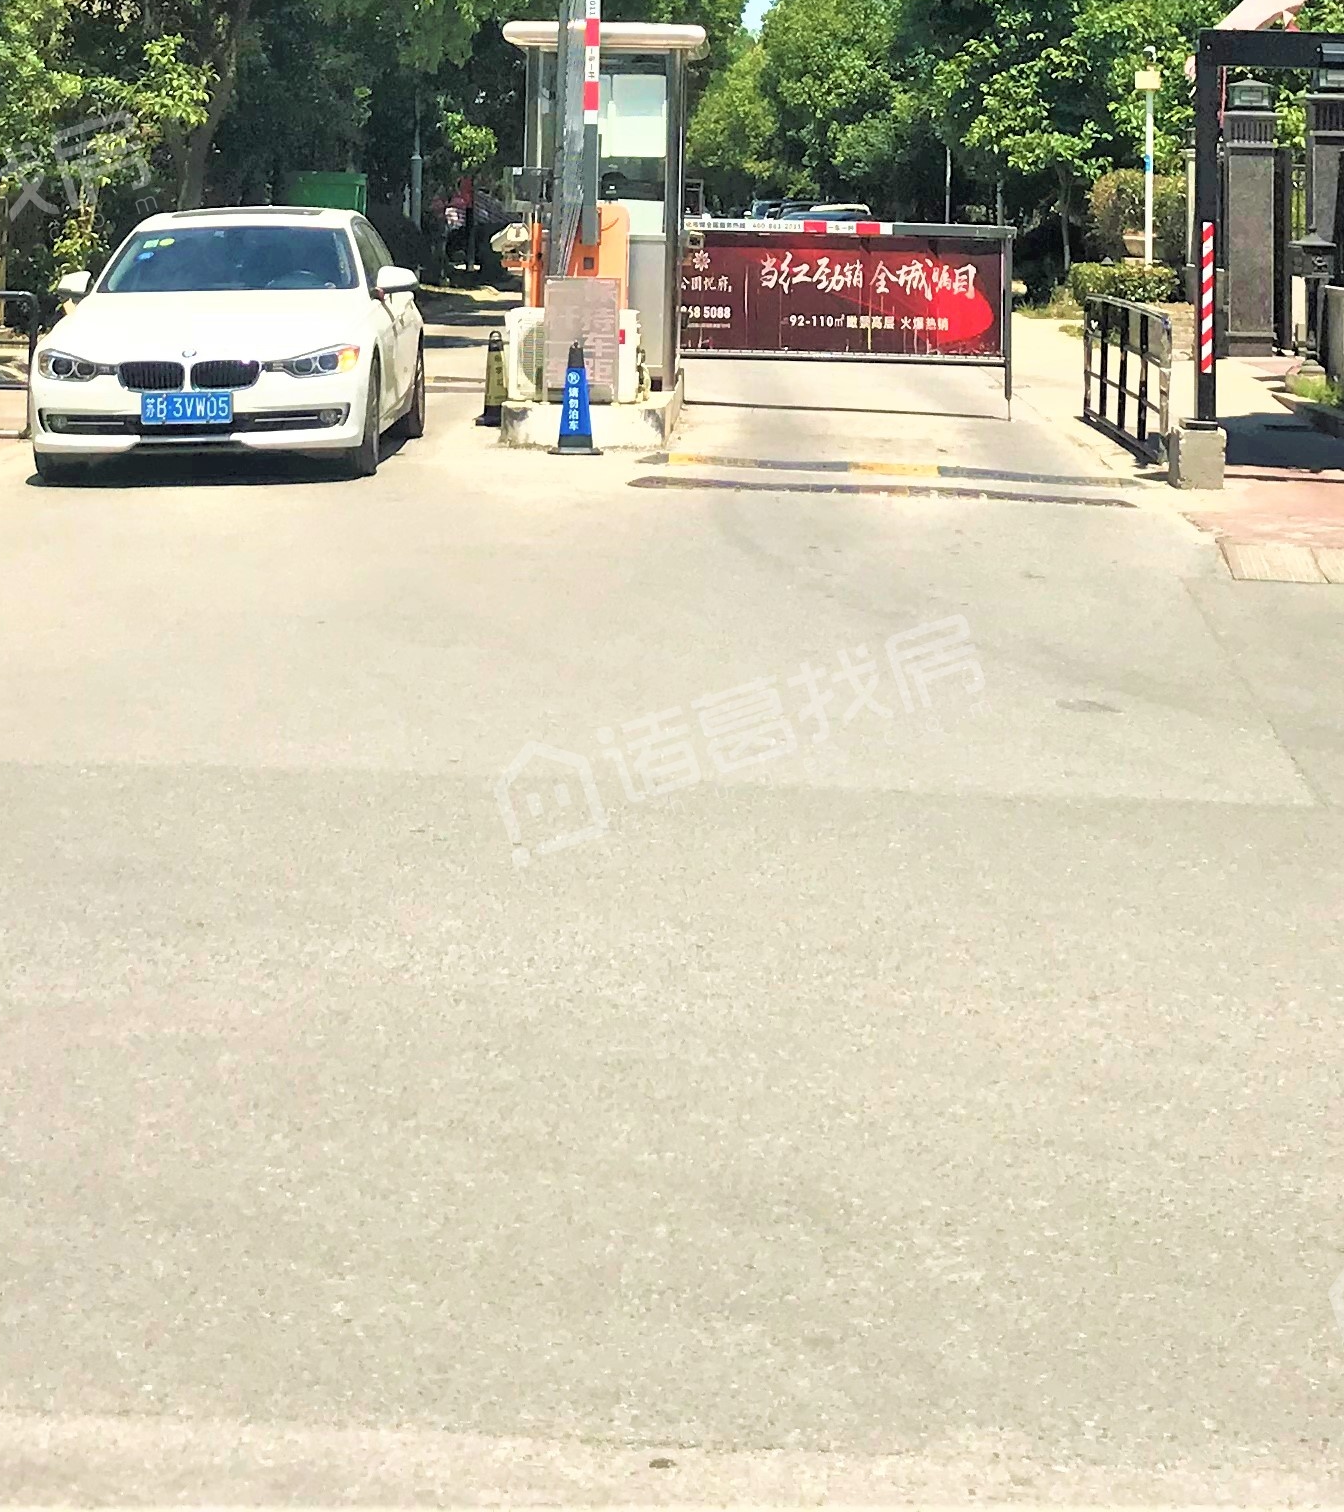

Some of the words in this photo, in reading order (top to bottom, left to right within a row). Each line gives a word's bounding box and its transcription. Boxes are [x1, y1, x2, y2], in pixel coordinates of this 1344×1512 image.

[870, 259, 977, 301] 全城瞩目
[703, 306, 731, 319] 5088
[568, 387, 579, 431] 请勿泊车
